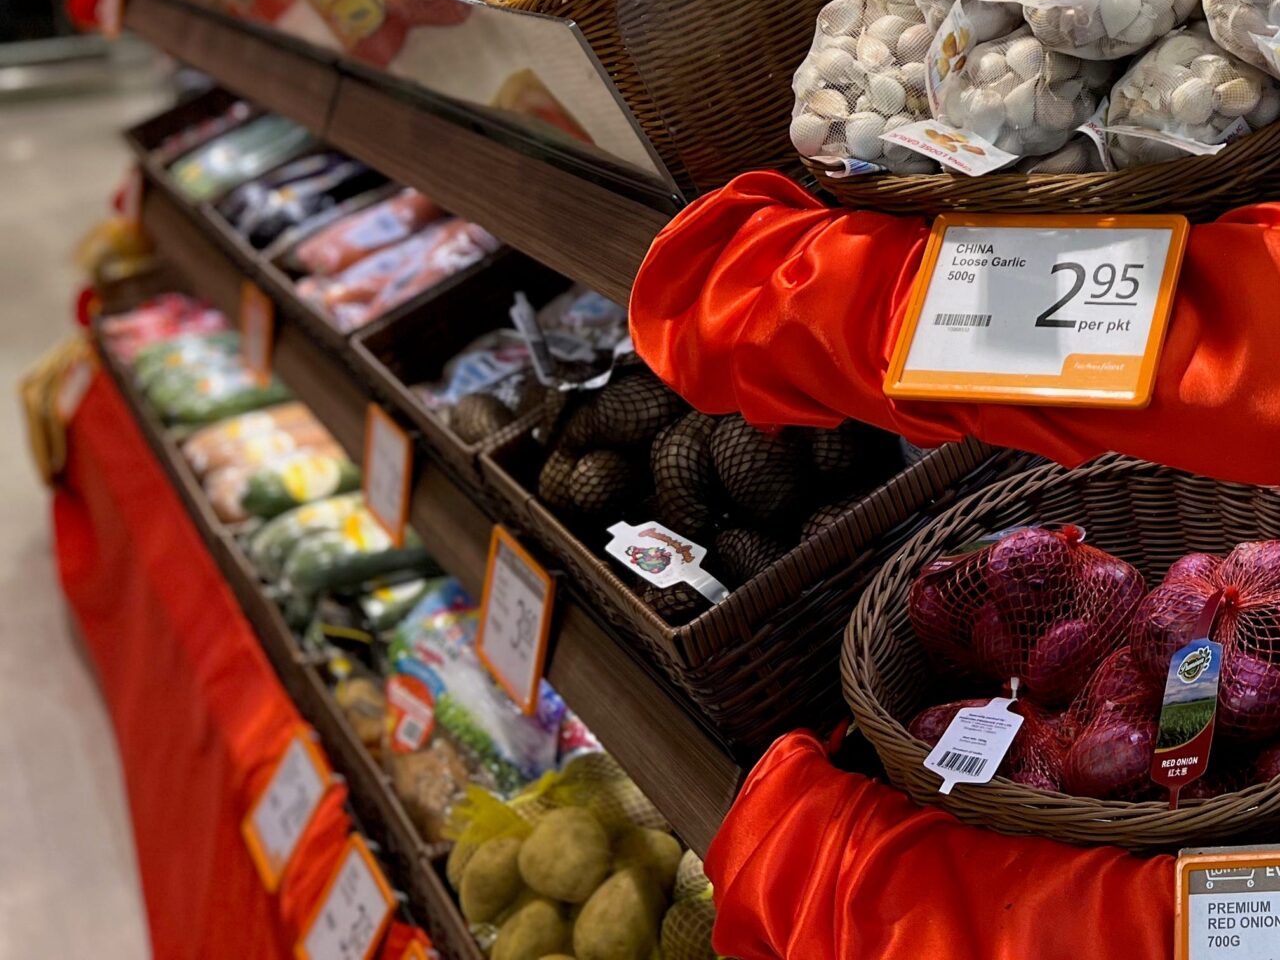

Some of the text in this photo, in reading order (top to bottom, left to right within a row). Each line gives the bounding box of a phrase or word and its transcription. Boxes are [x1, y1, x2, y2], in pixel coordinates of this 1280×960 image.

[919, 143, 949, 158] LOOSE
[956, 243, 994, 255] CHINA
[952, 256, 1027, 268] Loose Garlic
[947, 270, 976, 284] 500g
[1078, 319, 1131, 333] per pkt
[1161, 756, 1199, 768] RED ONION
[1207, 900, 1271, 915] PREMIUM
[1207, 916, 1236, 930] RED
[1207, 935, 1241, 948] 700G
